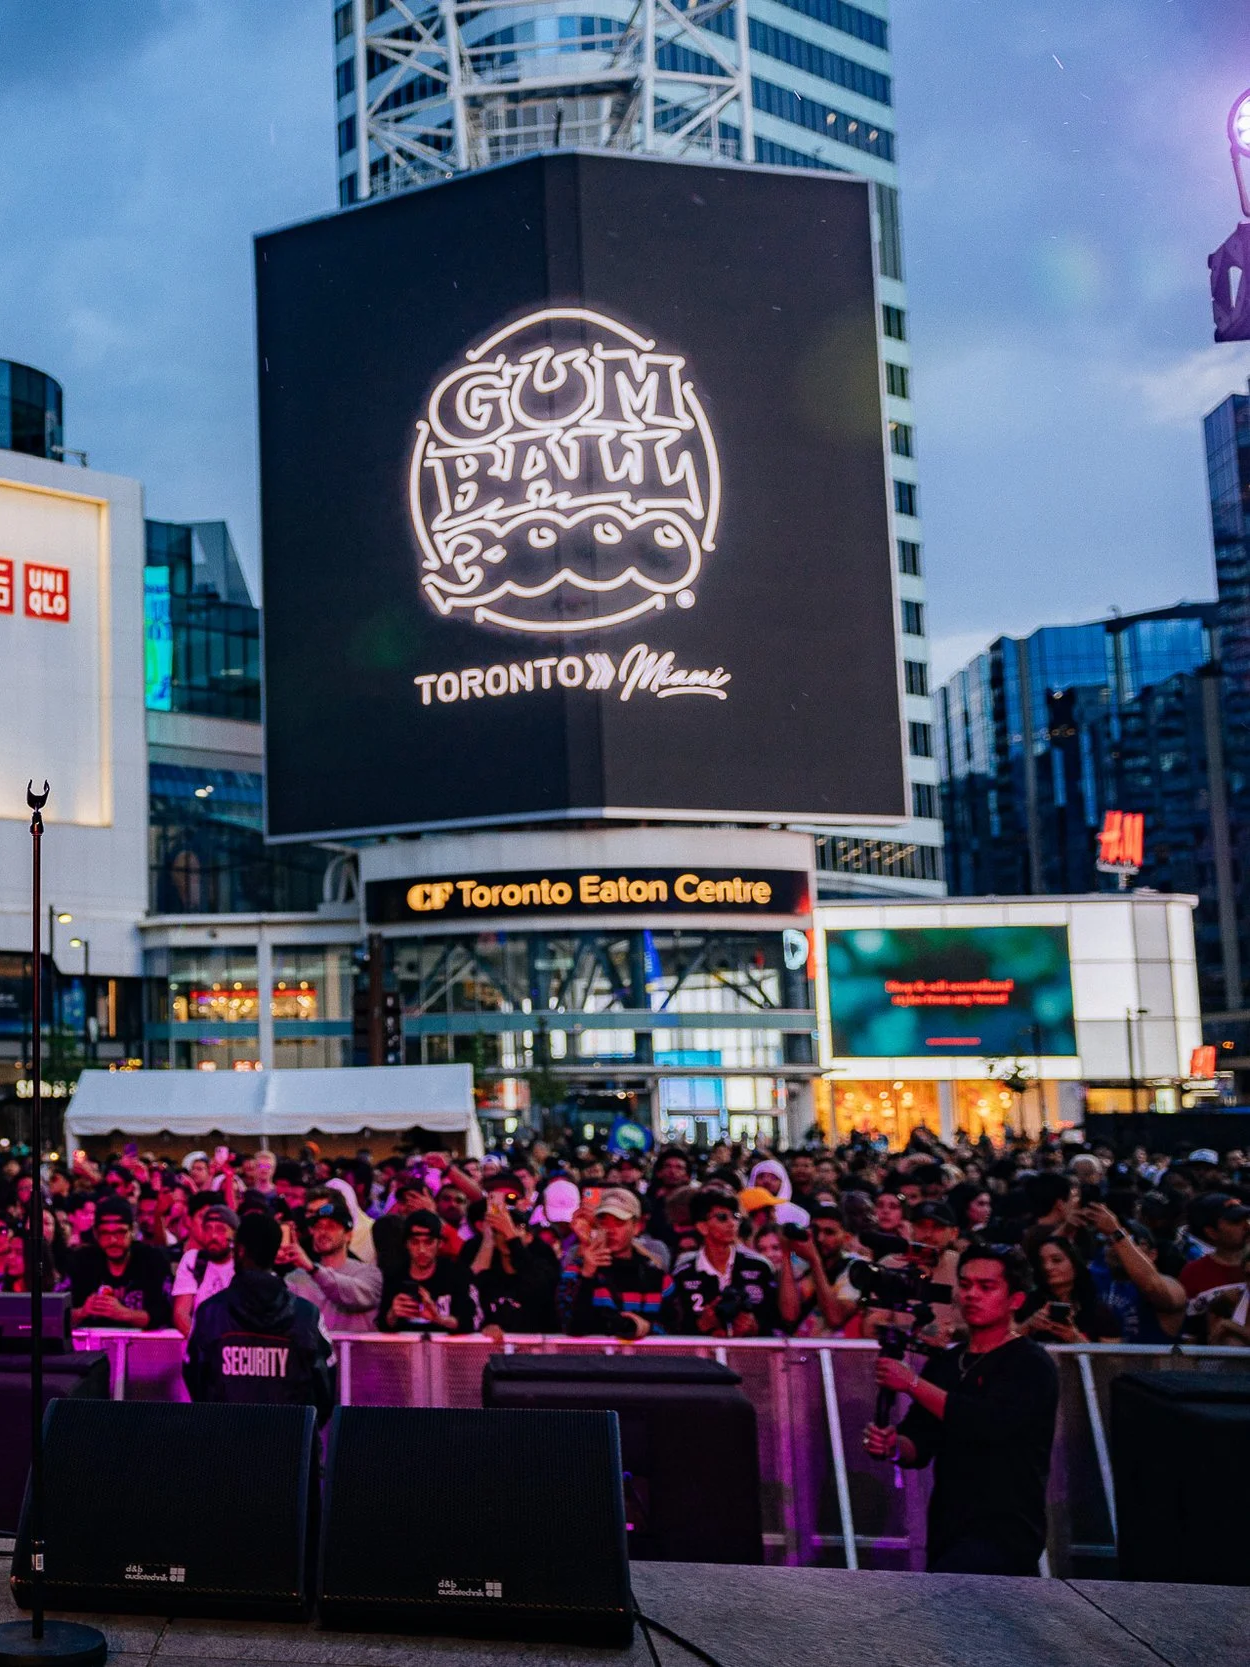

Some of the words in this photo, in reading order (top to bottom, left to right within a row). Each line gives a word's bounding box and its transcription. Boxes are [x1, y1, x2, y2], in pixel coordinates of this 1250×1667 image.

[428, 345, 696, 447] GUM
[423, 427, 706, 531] BALL
[28, 567, 64, 594] UNI
[28, 590, 67, 616] QLO
[413, 656, 585, 706] TORONTO
[617, 643, 732, 701] Miami
[406, 881, 454, 912] CF
[455, 878, 573, 909] Toronto
[579, 874, 668, 904] Eaton
[673, 873, 772, 904] Centre
[221, 1346, 290, 1378] SECURITY
[125, 1564, 144, 1573] d&b
[437, 1579, 458, 1588] d&b
